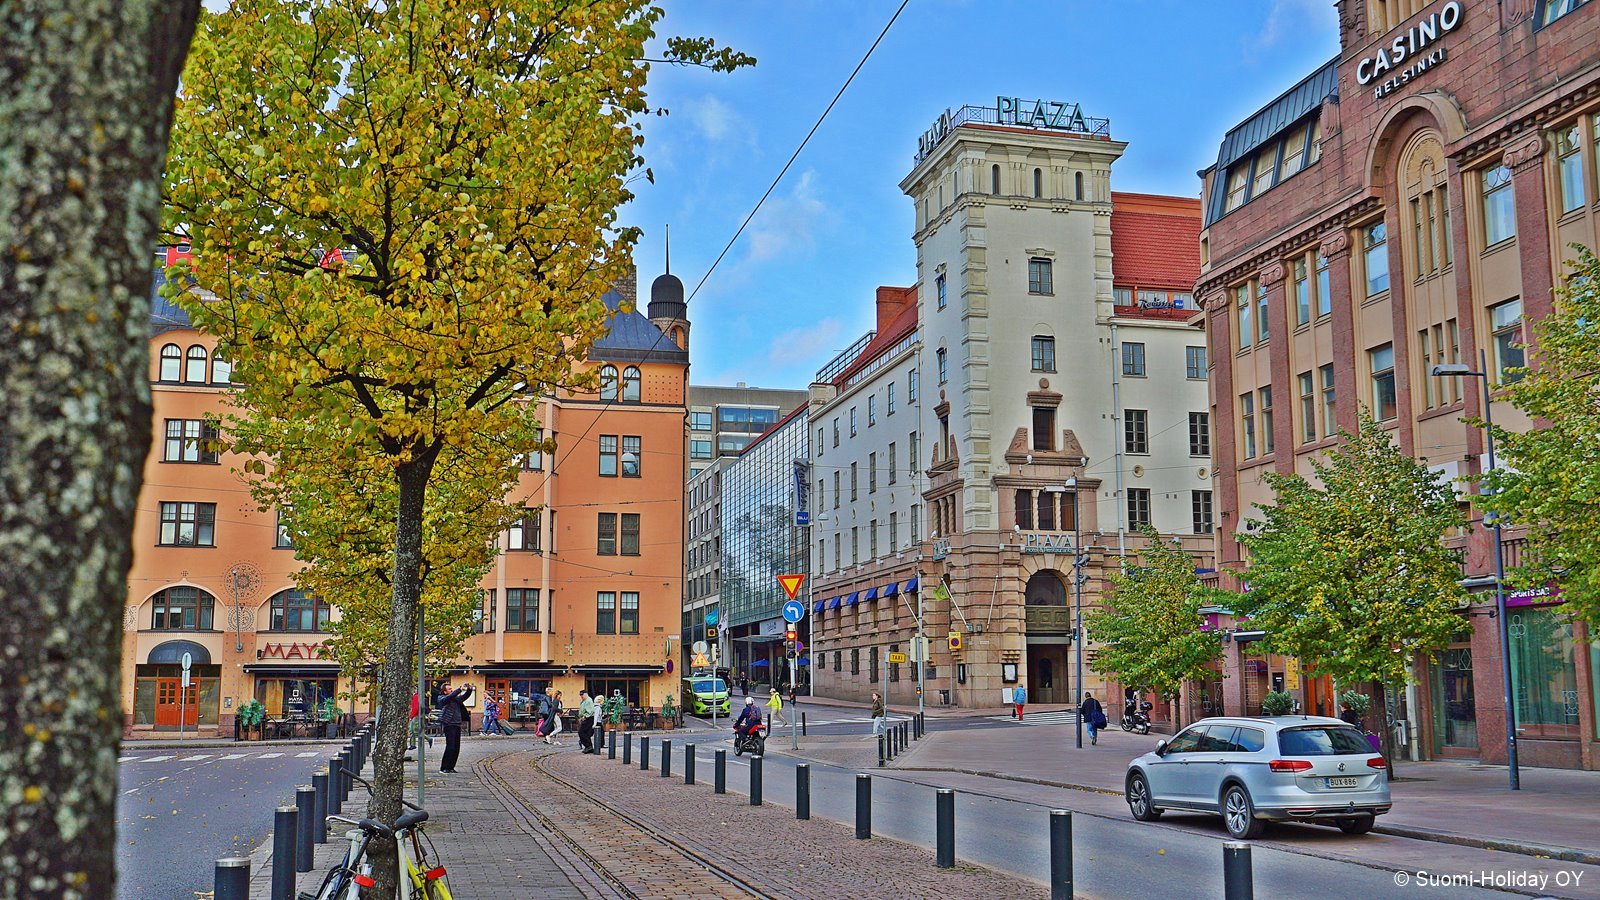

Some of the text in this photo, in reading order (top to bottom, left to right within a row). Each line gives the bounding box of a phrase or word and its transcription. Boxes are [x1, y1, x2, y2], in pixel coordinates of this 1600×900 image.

[1357, 1, 1463, 85] CASINO
[1375, 48, 1446, 99] HELSINKI
[997, 96, 1090, 132] PLAZA
[918, 107, 952, 159] PLAZA
[1027, 533, 1072, 547] PLAZA
[262, 642, 332, 660] MAYA
[1330, 778, 1357, 786] BUX-886
